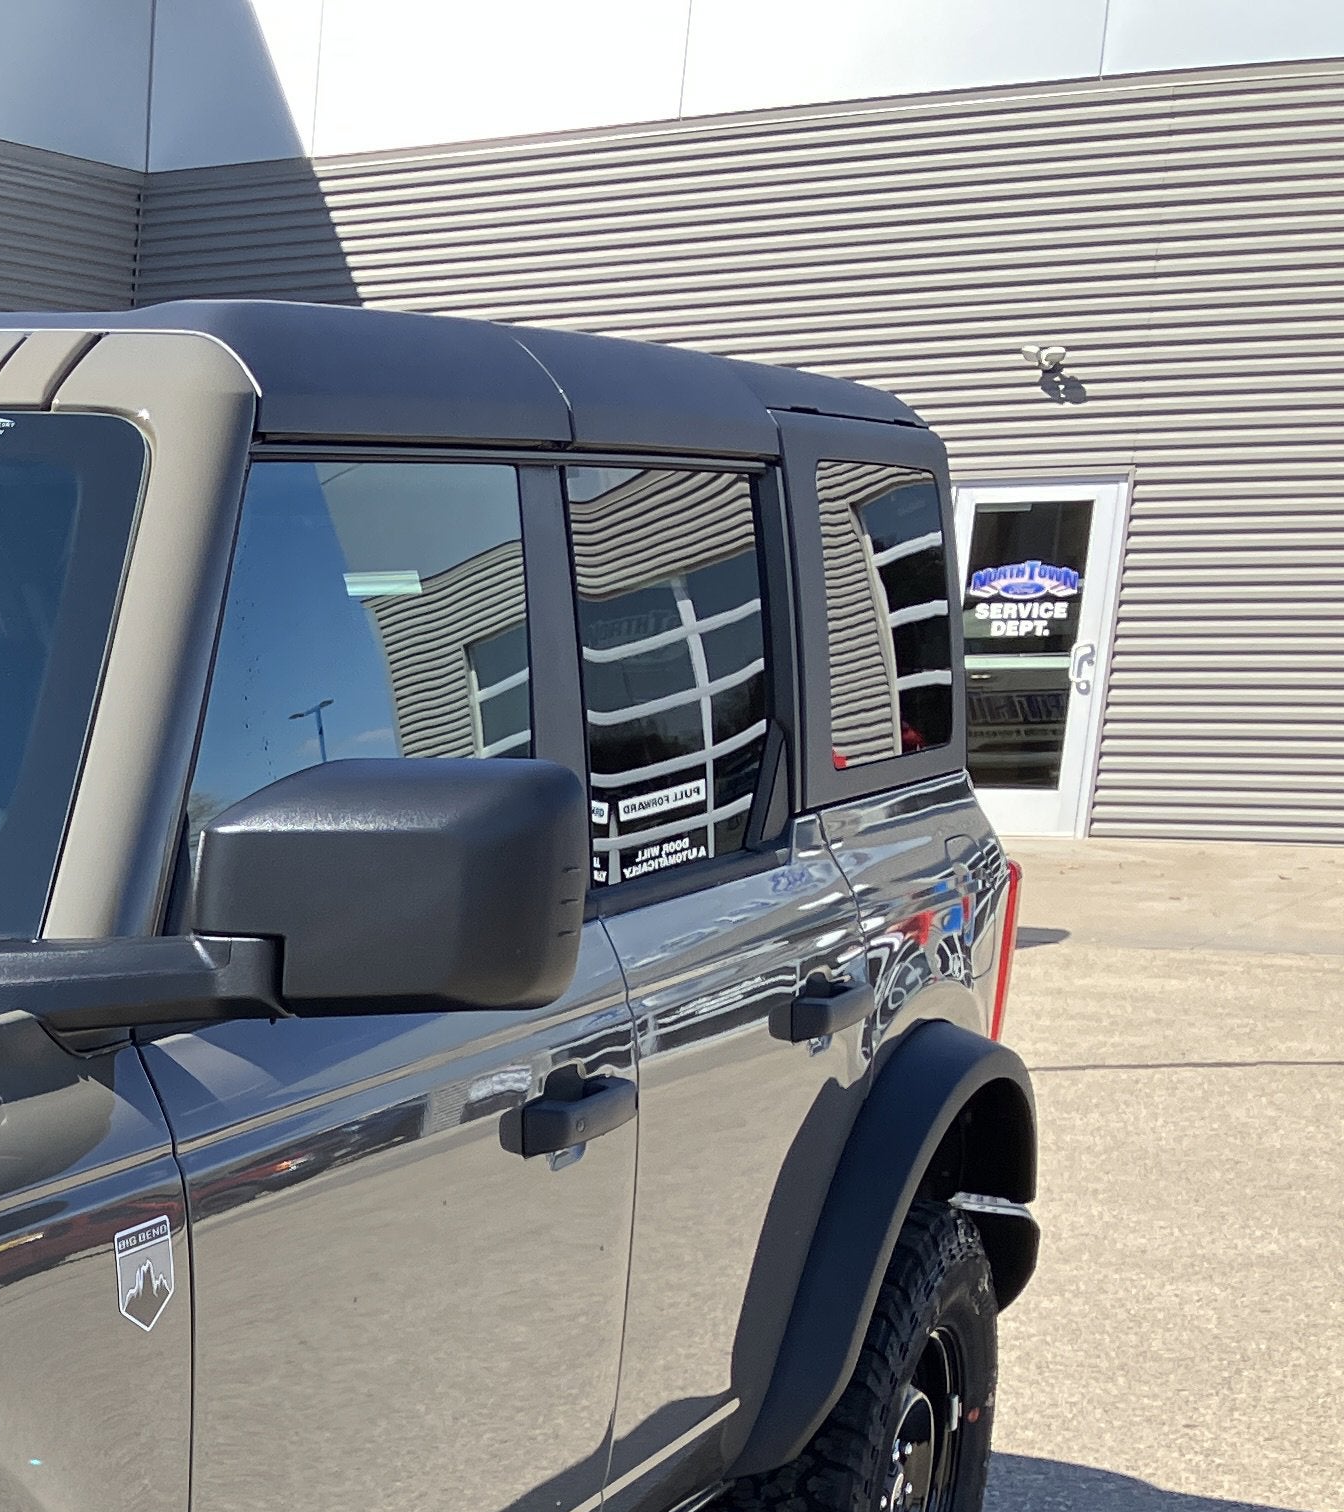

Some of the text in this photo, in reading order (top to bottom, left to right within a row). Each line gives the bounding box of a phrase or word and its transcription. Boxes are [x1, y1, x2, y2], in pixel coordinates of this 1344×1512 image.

[974, 602, 1069, 619] SERVICE
[990, 620, 1050, 636] DEPT.
[118, 1224, 167, 1251] BIG BEND
